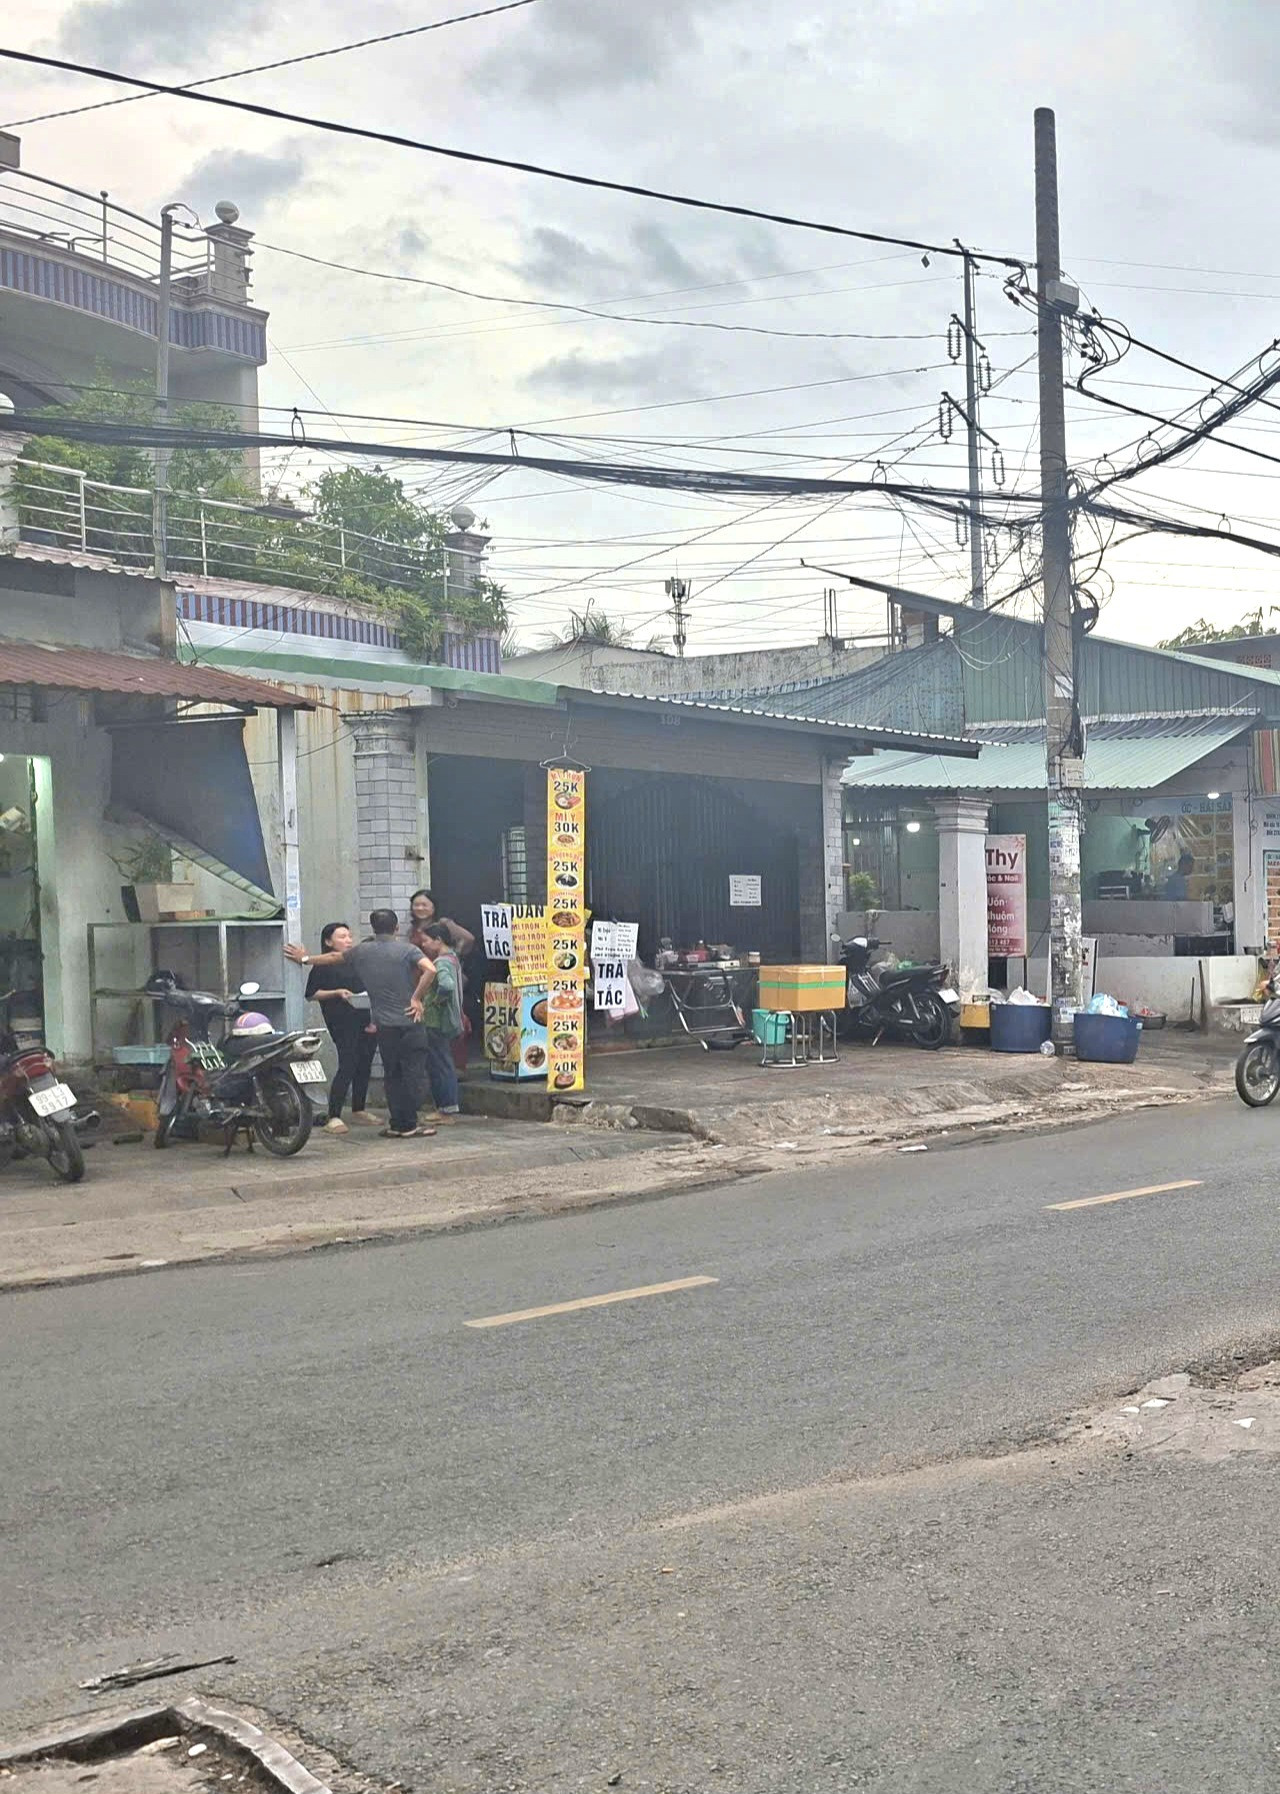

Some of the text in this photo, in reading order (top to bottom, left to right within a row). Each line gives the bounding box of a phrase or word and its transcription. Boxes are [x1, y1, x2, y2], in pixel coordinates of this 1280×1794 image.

[553, 780, 578, 793] 25K
[554, 822, 579, 834] 30K
[985, 848, 1019, 870] Thy
[553, 861, 578, 873] 25K
[553, 898, 577, 910] 25K
[484, 907, 509, 929] TRÀ
[486, 934, 511, 957] TẮC
[553, 939, 578, 950] 25K
[598, 959, 624, 979] TRÀ
[553, 980, 578, 991] 25K
[597, 984, 623, 1006] TẮC
[485, 1005, 519, 1027] 25K
[553, 1020, 578, 1032] 25K
[553, 1061, 578, 1073] 40K
